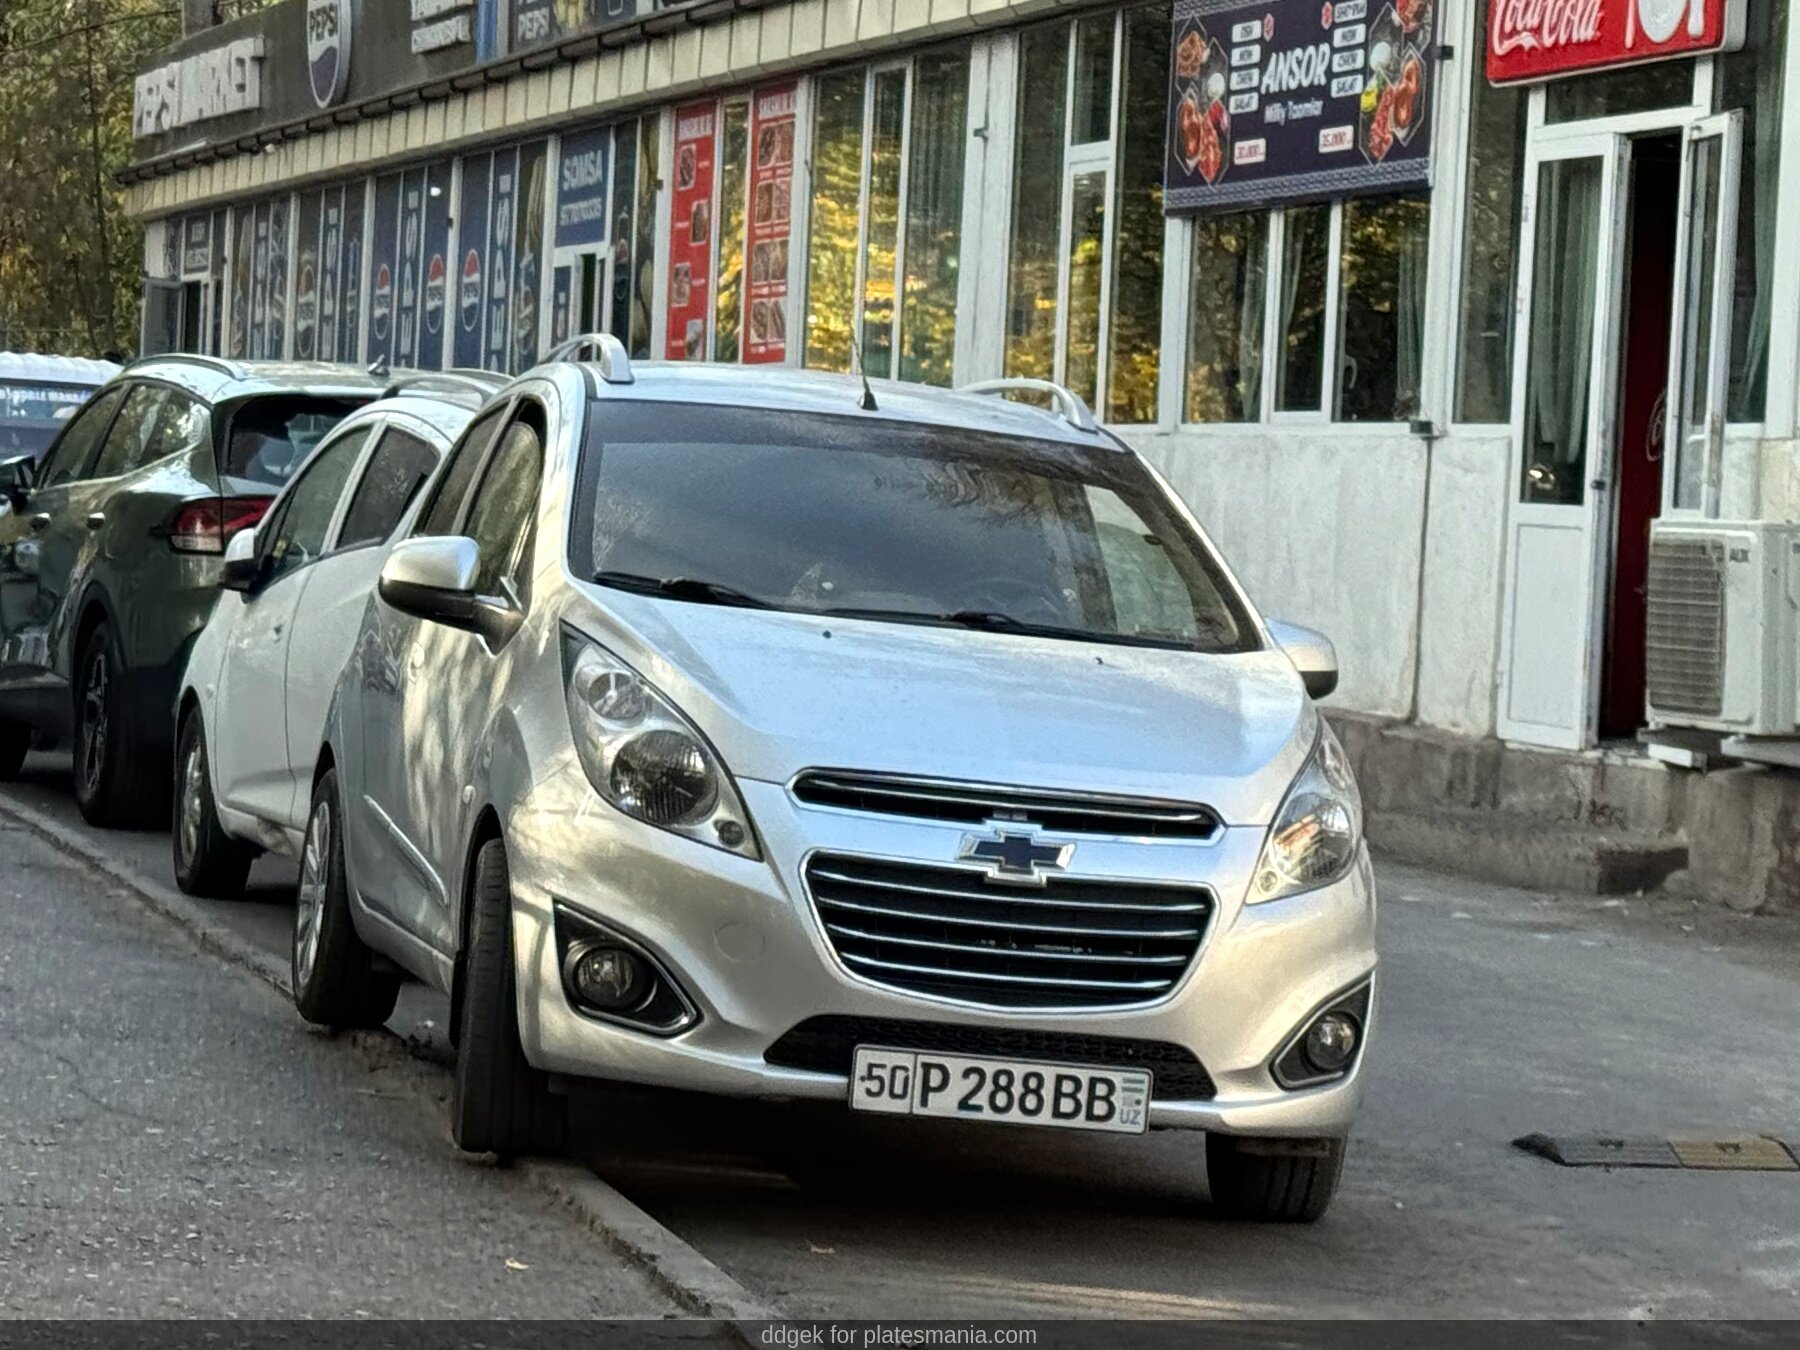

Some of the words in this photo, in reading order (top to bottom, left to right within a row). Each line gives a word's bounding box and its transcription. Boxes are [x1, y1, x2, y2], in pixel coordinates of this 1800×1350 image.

[309, 6, 338, 42] PEPSI
[518, 7, 549, 43] PEPSI
[1260, 42, 1331, 95] ANSOR
[562, 150, 603, 192] SOMSA
[400, 190, 420, 367] EPSI
[864, 1062, 910, 1101] 50
[1119, 1109, 1142, 1127] UZ
